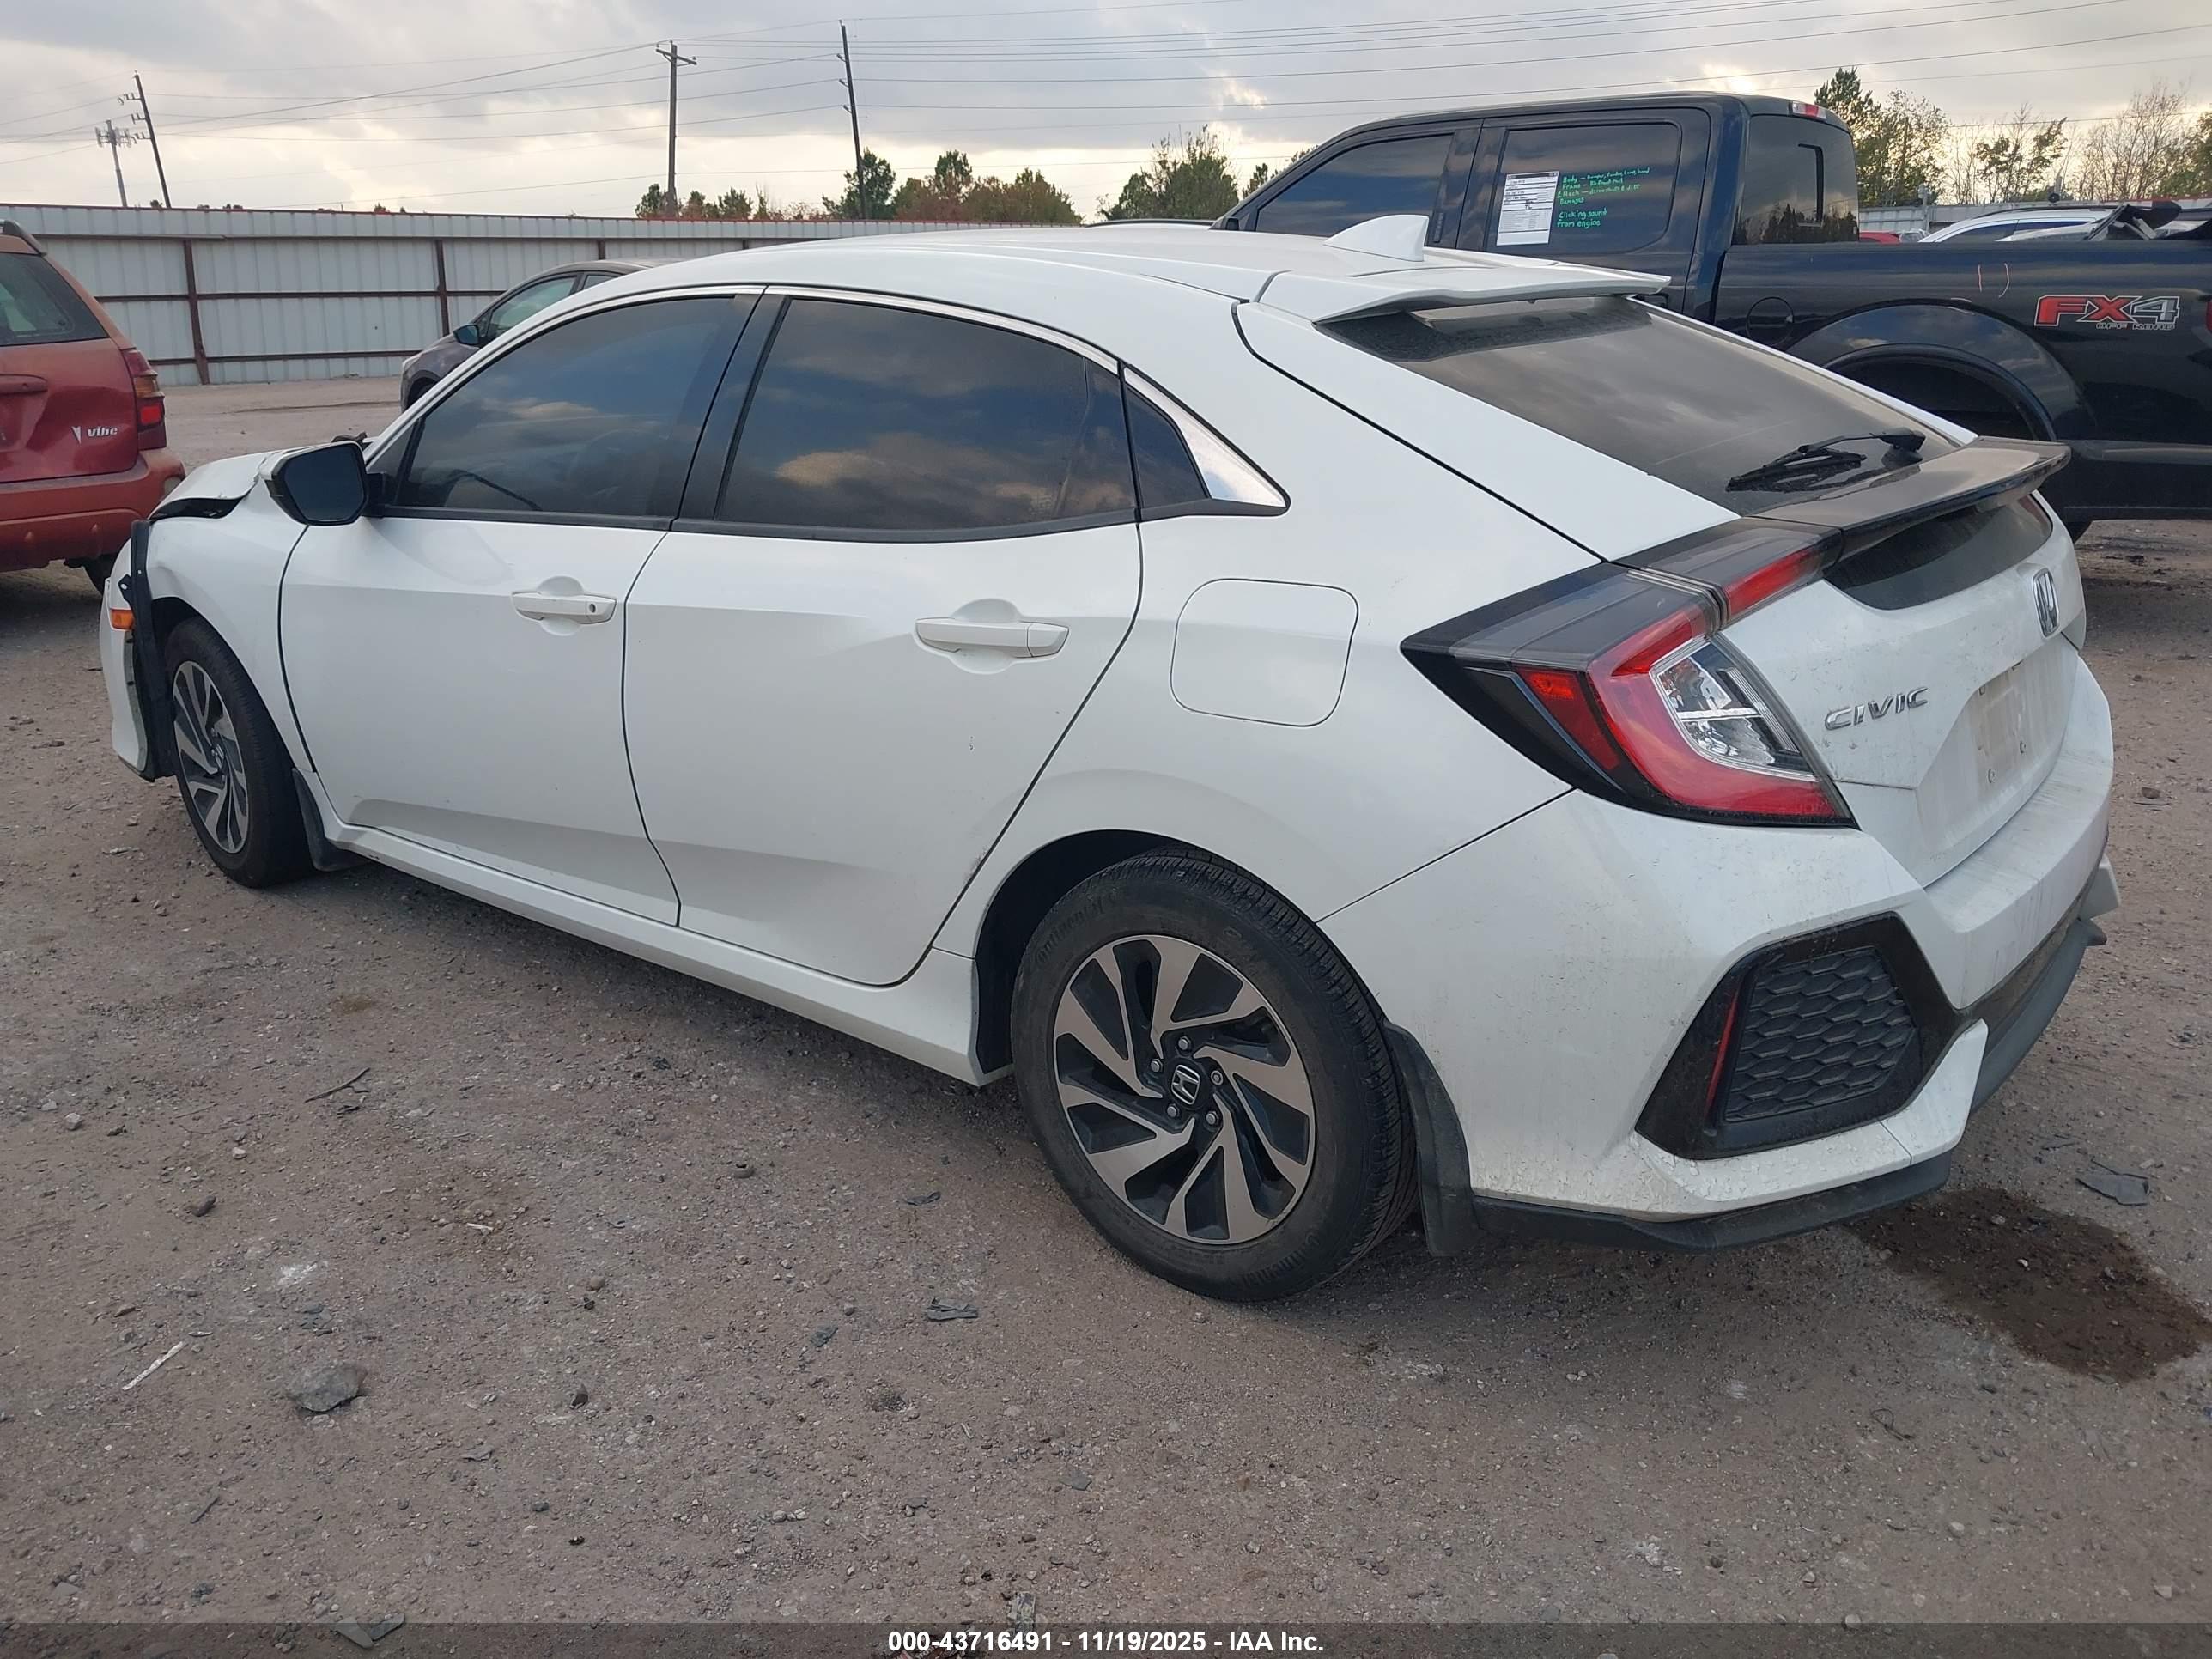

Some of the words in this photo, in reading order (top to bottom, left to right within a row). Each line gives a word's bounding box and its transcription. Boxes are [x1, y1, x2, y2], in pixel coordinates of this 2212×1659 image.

[1559, 210, 1587, 220] Clicking
[1587, 207, 1607, 217] sound
[1557, 218, 1575, 228] from
[1577, 218, 1601, 229] engine
[2033, 295, 2180, 326] FX4
[87, 426, 118, 437] vibe
[1825, 687, 1929, 731] CIVIC
